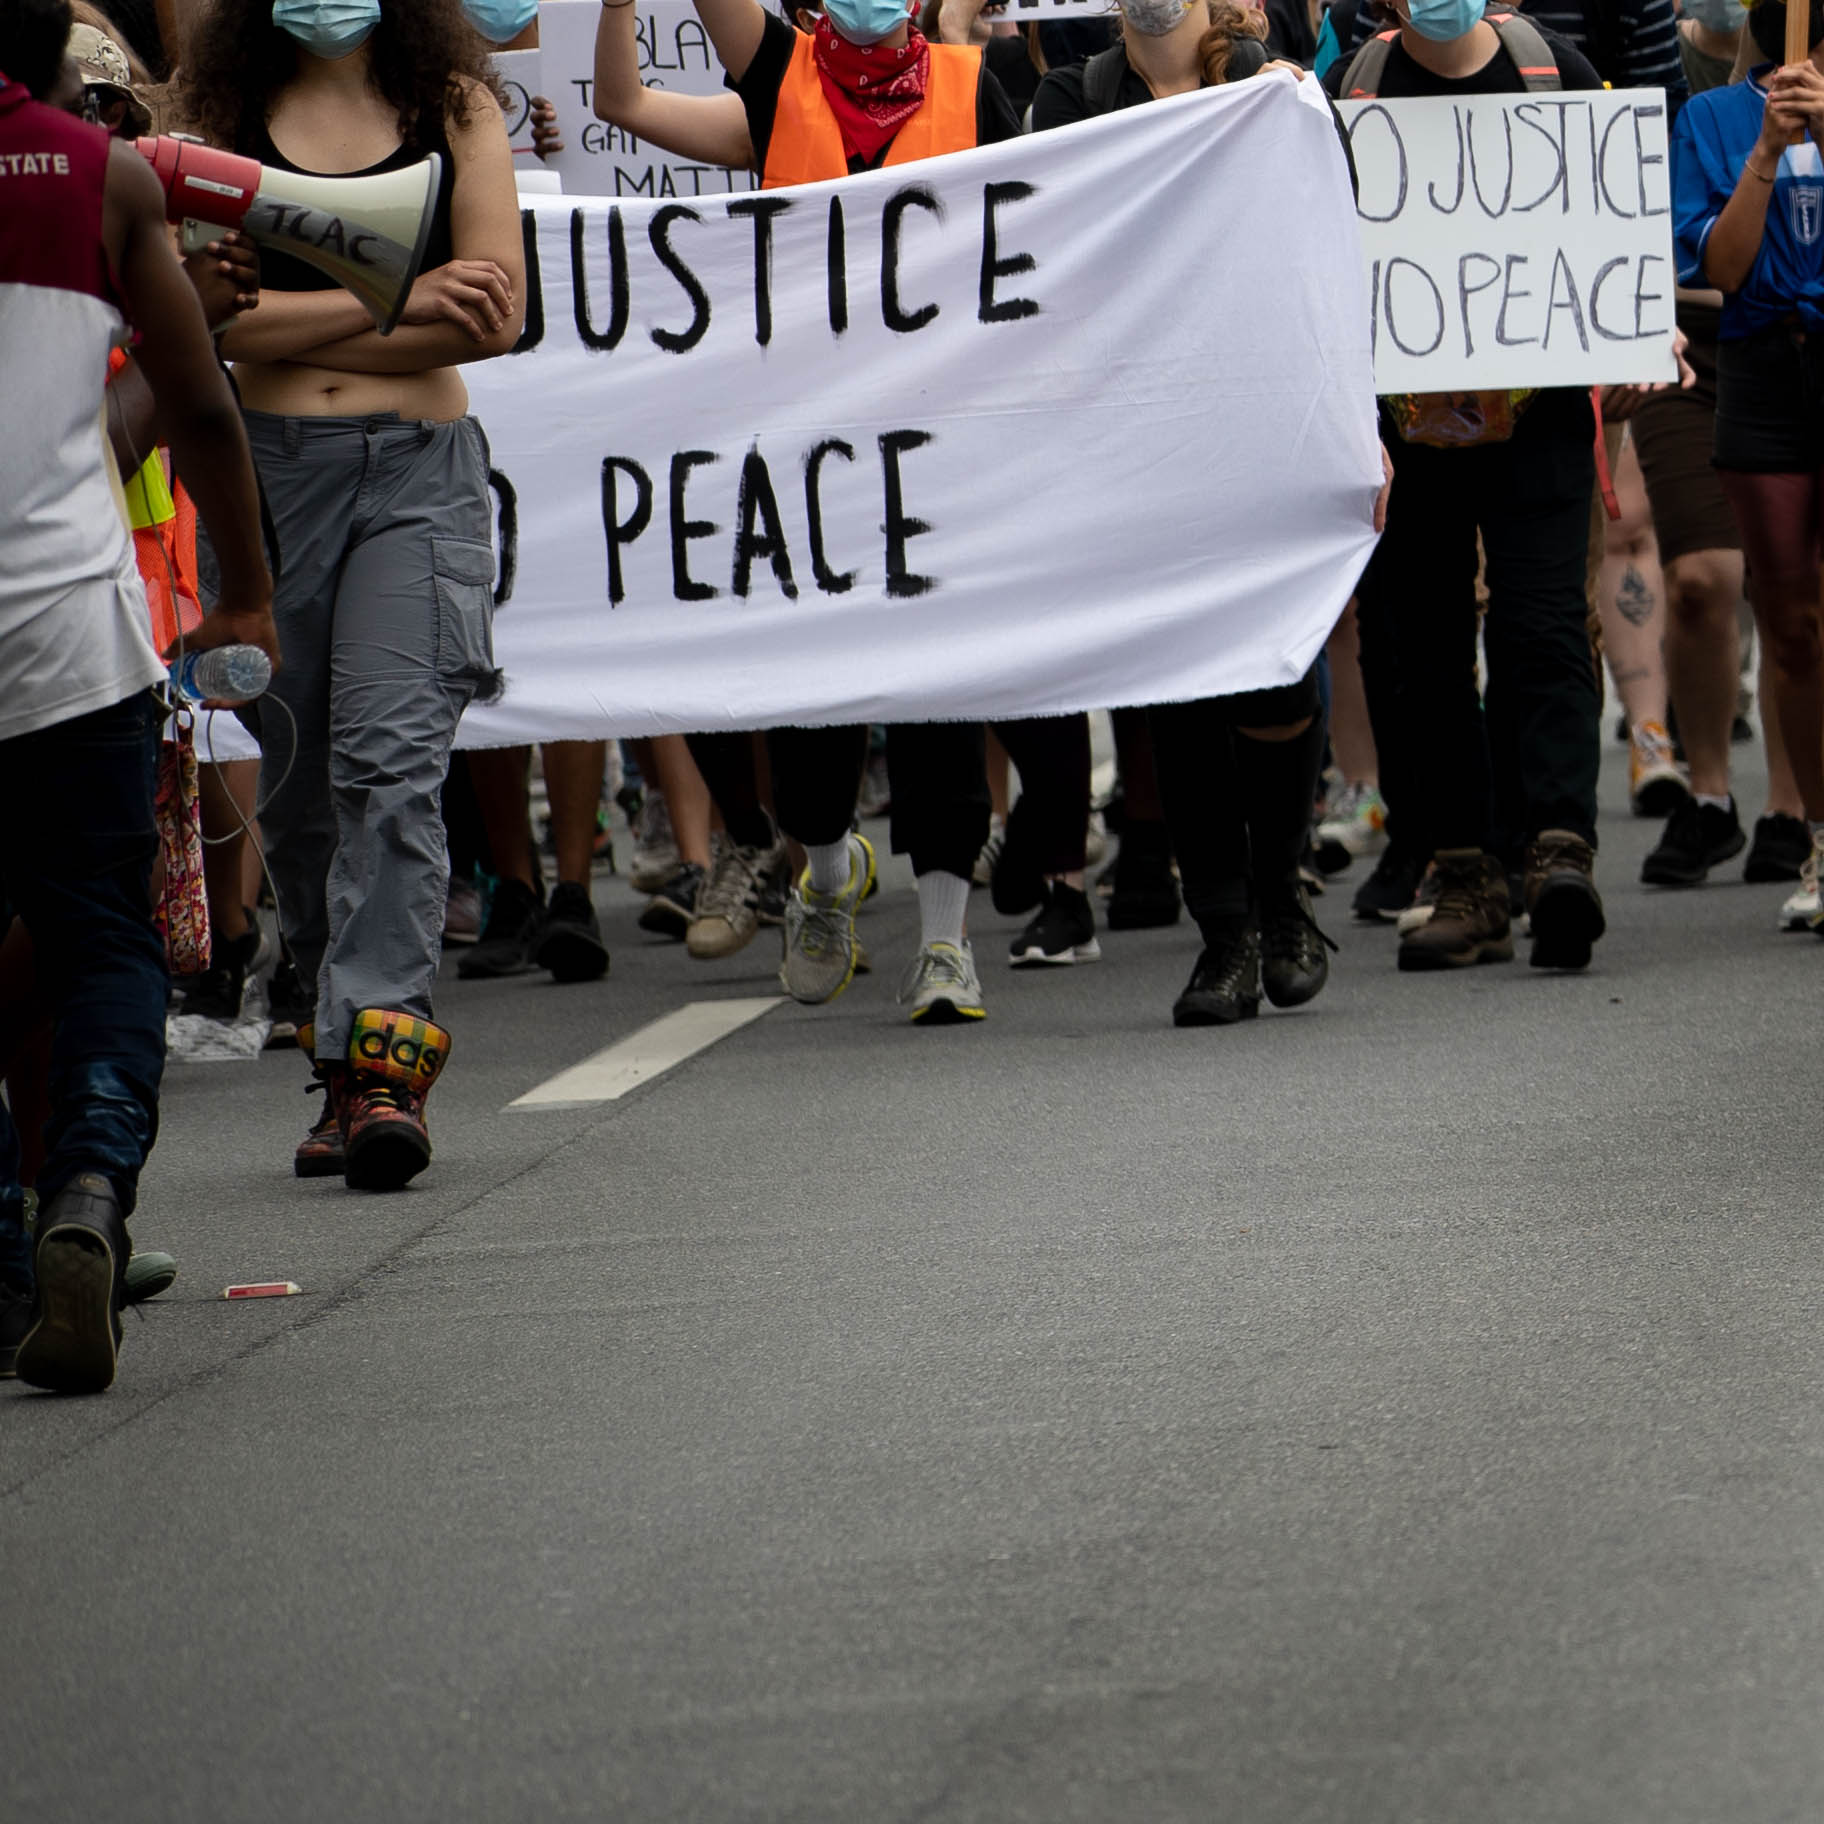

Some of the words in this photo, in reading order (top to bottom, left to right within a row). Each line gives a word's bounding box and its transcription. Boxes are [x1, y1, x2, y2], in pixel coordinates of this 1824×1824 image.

[614, 163, 762, 198] MATT
[1427, 99, 1670, 221] JUSTICE
[509, 179, 1048, 356] JUSTICE
[1457, 246, 1671, 360] PEACE
[599, 427, 942, 612] PEACE
